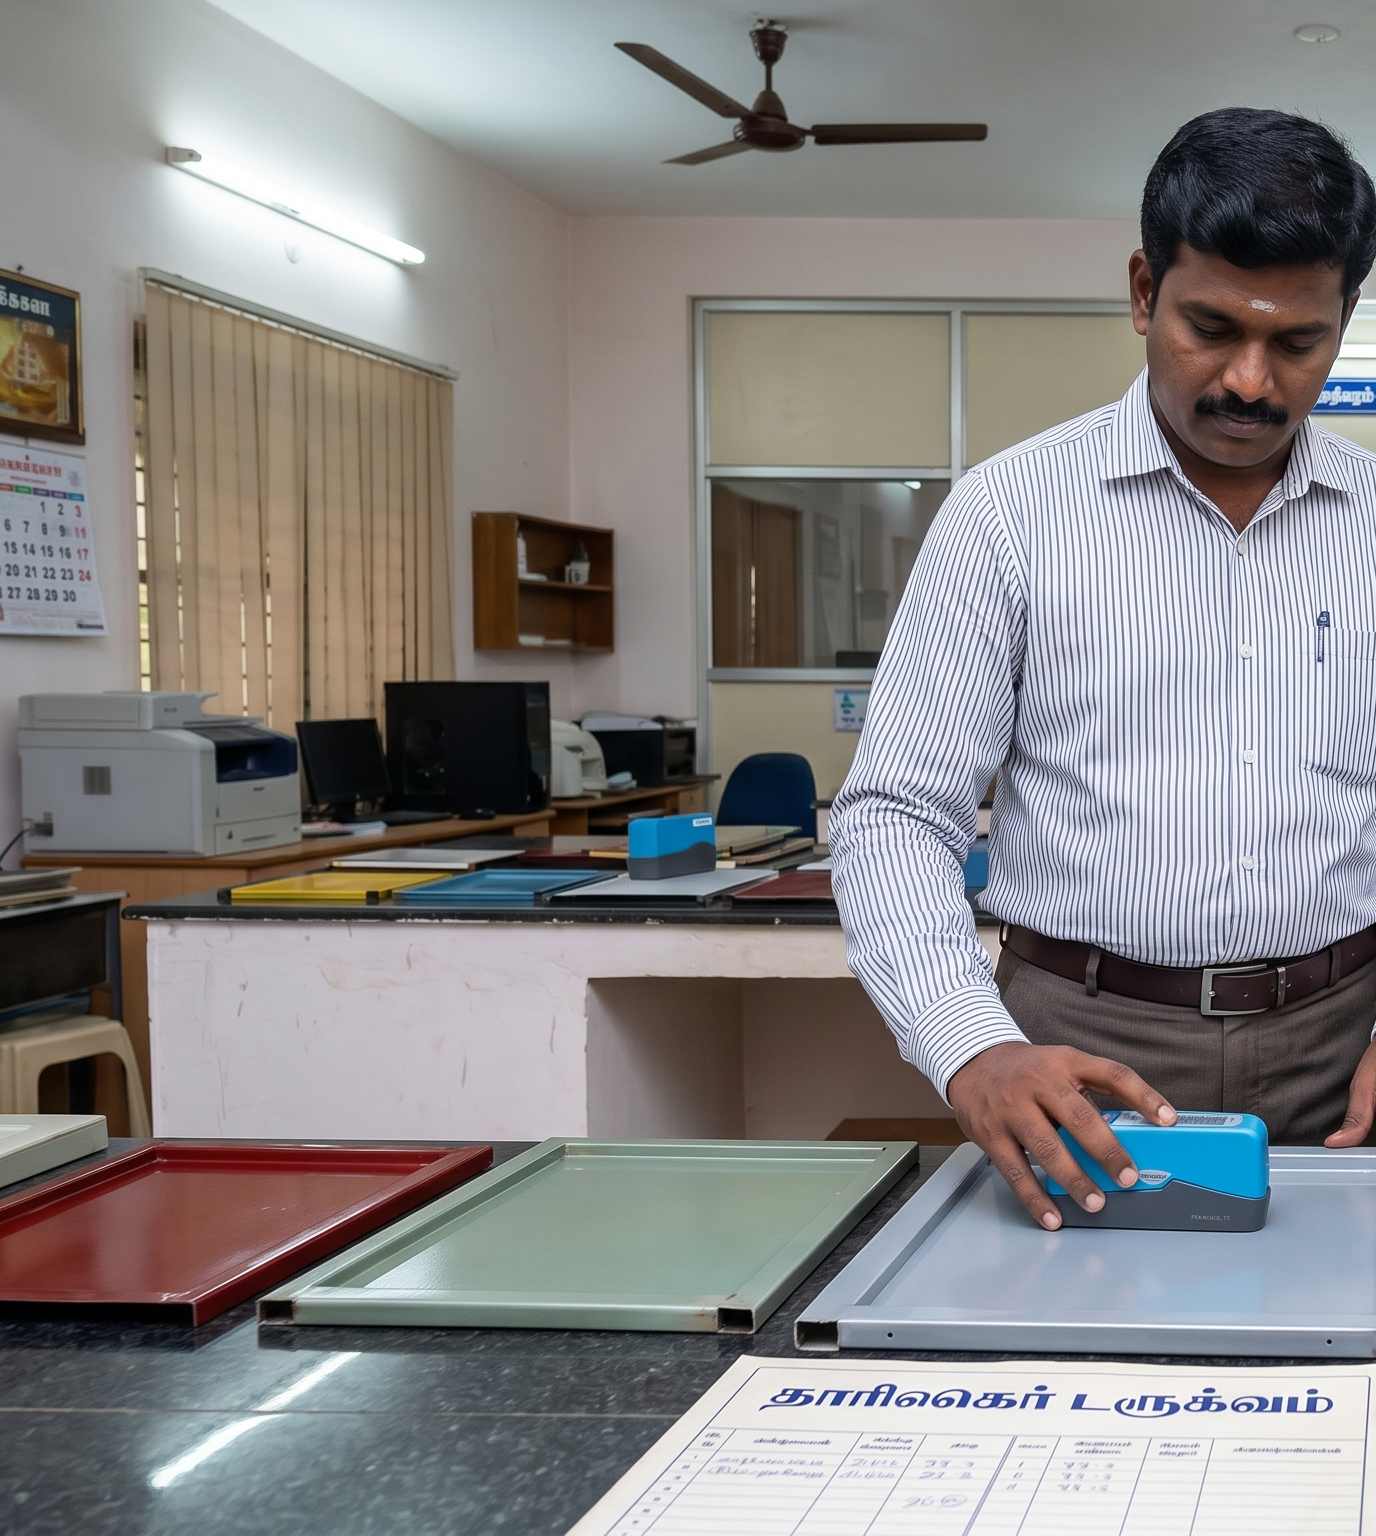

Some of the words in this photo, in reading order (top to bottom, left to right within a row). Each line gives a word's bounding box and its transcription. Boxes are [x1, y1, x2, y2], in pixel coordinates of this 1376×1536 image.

[40, 501, 45, 513] 1
[57, 503, 64, 515] 2
[75, 505, 82, 517] 3
[4, 518, 11, 531] 6
[23, 520, 29, 533] 7
[41, 522, 48, 535] 8
[59, 524, 66, 537] 9
[22, 543, 36, 555] 14
[41, 545, 54, 557] 15
[59, 546, 72, 559] 16
[77, 548, 89, 560] 17
[5, 563, 20, 577] 20
[24, 565, 37, 578] 21
[42, 566, 56, 580] 22
[60, 568, 74, 581] 23
[78, 569, 92, 582] 24
[7, 586, 21, 599] 27
[26, 587, 40, 600] 28
[44, 588, 58, 602] 29
[62, 589, 76, 602] 30
